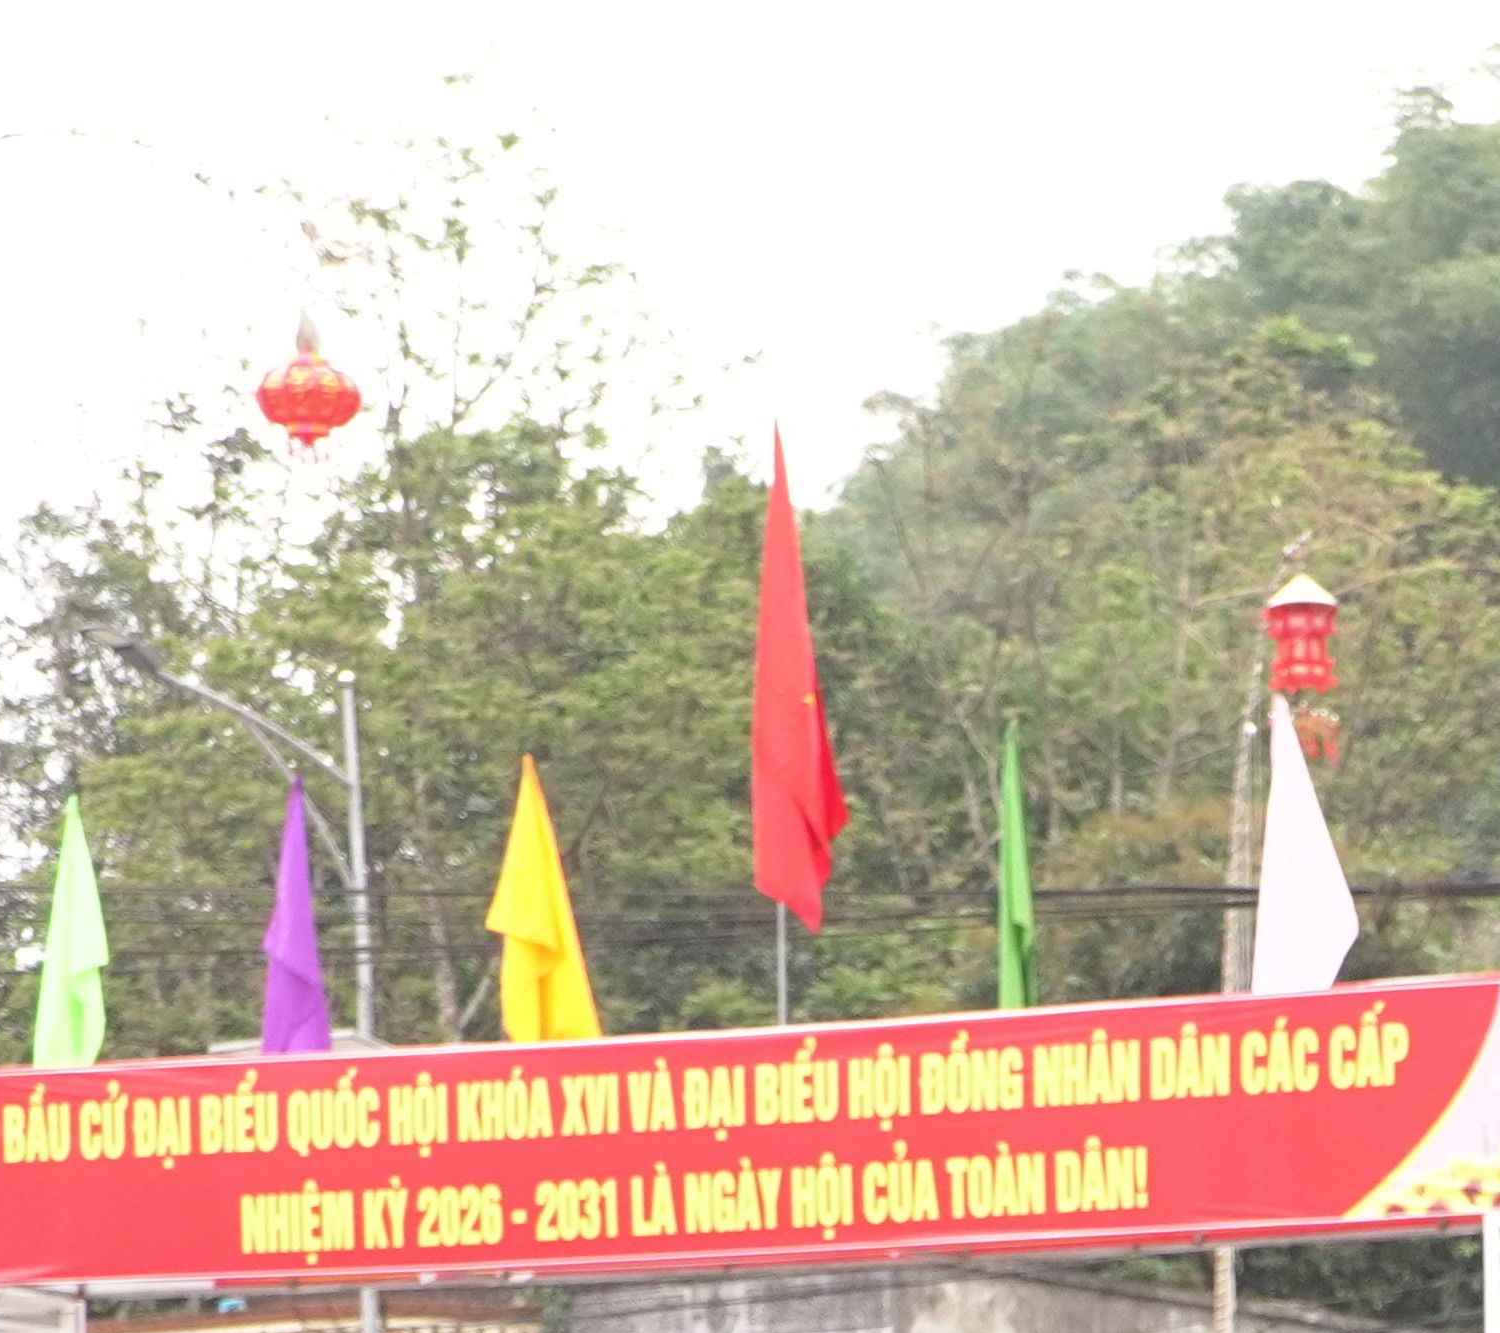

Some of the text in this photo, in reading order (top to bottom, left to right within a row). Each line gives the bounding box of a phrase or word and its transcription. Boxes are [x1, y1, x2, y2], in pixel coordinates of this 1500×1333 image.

[79, 1080, 129, 1161] CỬ
[132, 1097, 192, 1170] ĐẠI
[199, 1068, 279, 1155] BIỂU
[287, 1066, 381, 1158] QUỐC
[388, 1071, 449, 1158] HỘI
[456, 1066, 555, 1144] KHÓA
[560, 1073, 620, 1138] XVI
[626, 1057, 677, 1133] VÀ
[682, 1064, 746, 1142] ĐẠI
[754, 1036, 840, 1125] BIỂU
[847, 1043, 911, 1132] HỘI
[918, 1030, 1025, 1116] ĐỒNG
[1032, 1028, 1142, 1109] NHÂN
[1149, 1022, 1232, 1101] DÂN
[1239, 1016, 1320, 1096] CÁC
[1327, 1001, 1411, 1092] CẤP
[240, 1135, 1151, 1266] NHIỆM KỲ 2026 - 2031 LÀ NGÀY HỘI CỦA TOÀN DÂN!
